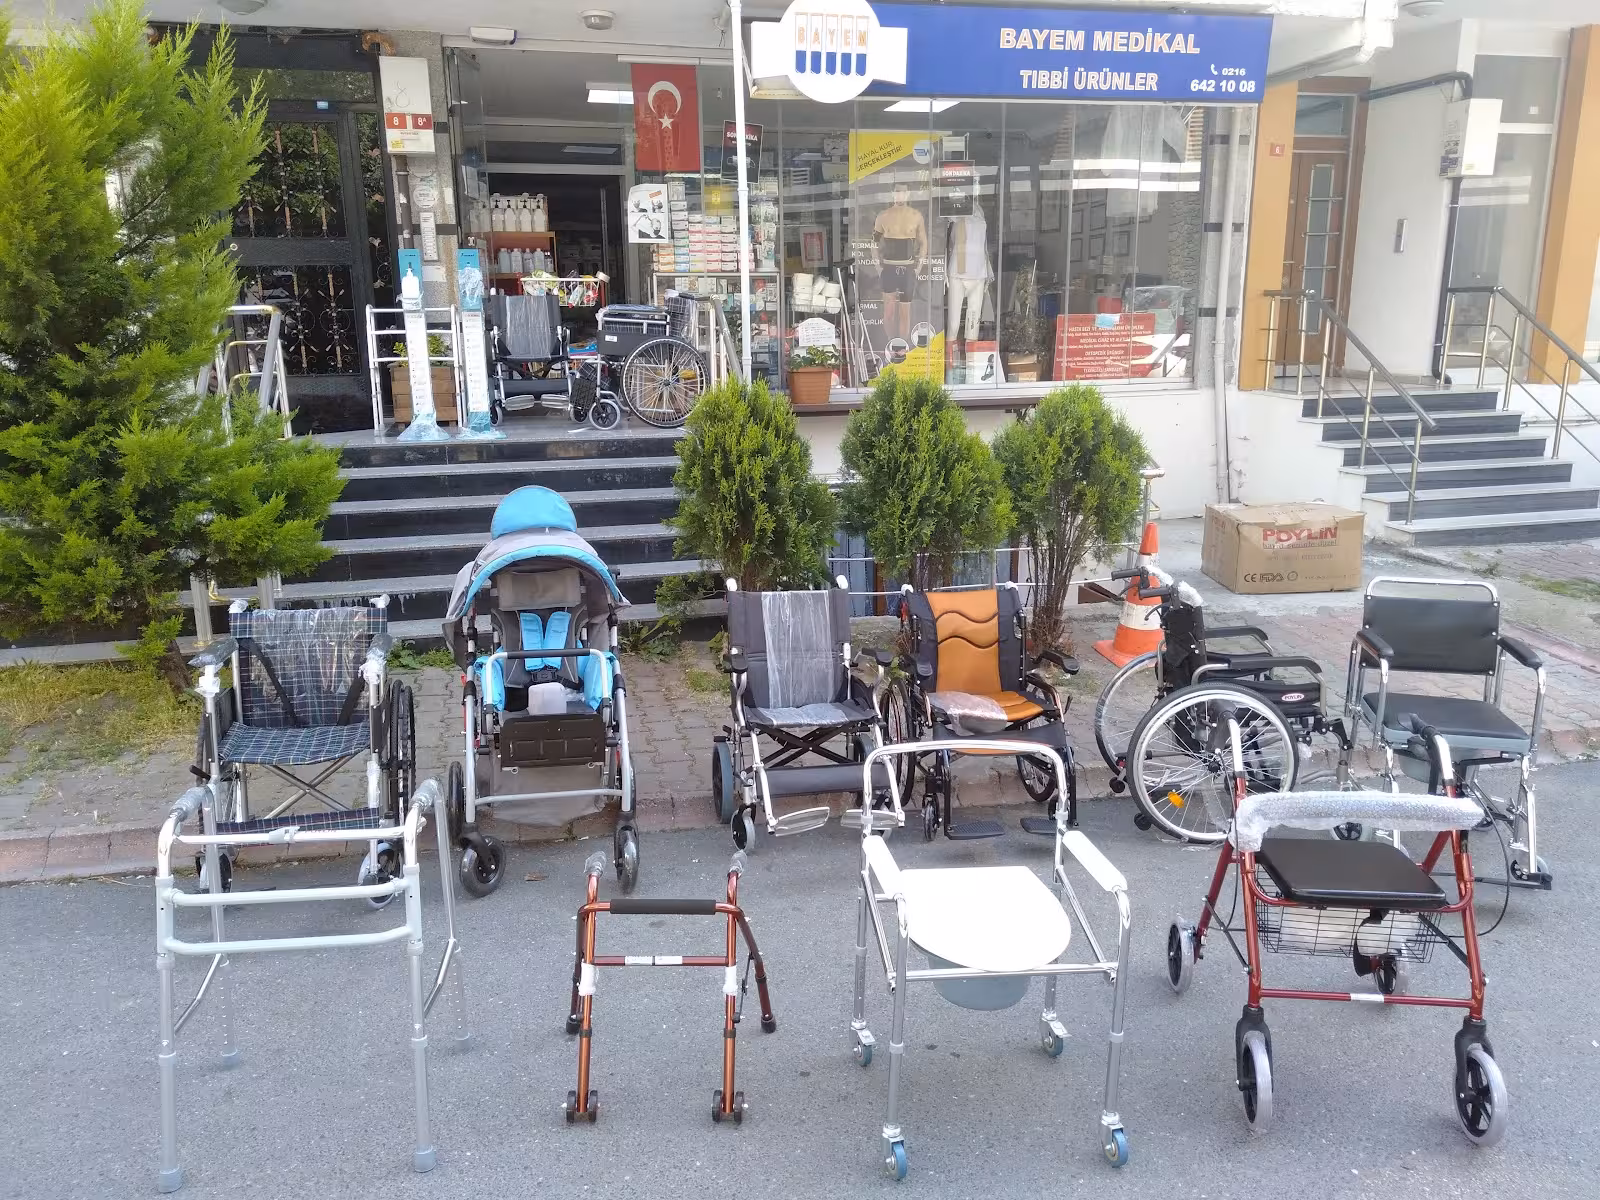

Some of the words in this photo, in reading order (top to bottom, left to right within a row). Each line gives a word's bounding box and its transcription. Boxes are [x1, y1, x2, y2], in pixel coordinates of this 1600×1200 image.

[797, 26, 867, 47] BAYEM
[999, 27, 1085, 51] BAYEM
[1092, 27, 1200, 54] MEDİKAL
[1019, 66, 1069, 90] TIBBİ
[1073, 67, 1158, 91] ÜRÜNLER
[1221, 67, 1246, 77] 0216
[1190, 79, 1215, 92] 642
[1219, 80, 1236, 93] 10
[1239, 80, 1256, 93] 08
[393, 116, 399, 126] 8
[857, 148, 879, 162] HAYAL
[1243, 573, 1257, 583] CE
[1259, 572, 1284, 583] FDA
